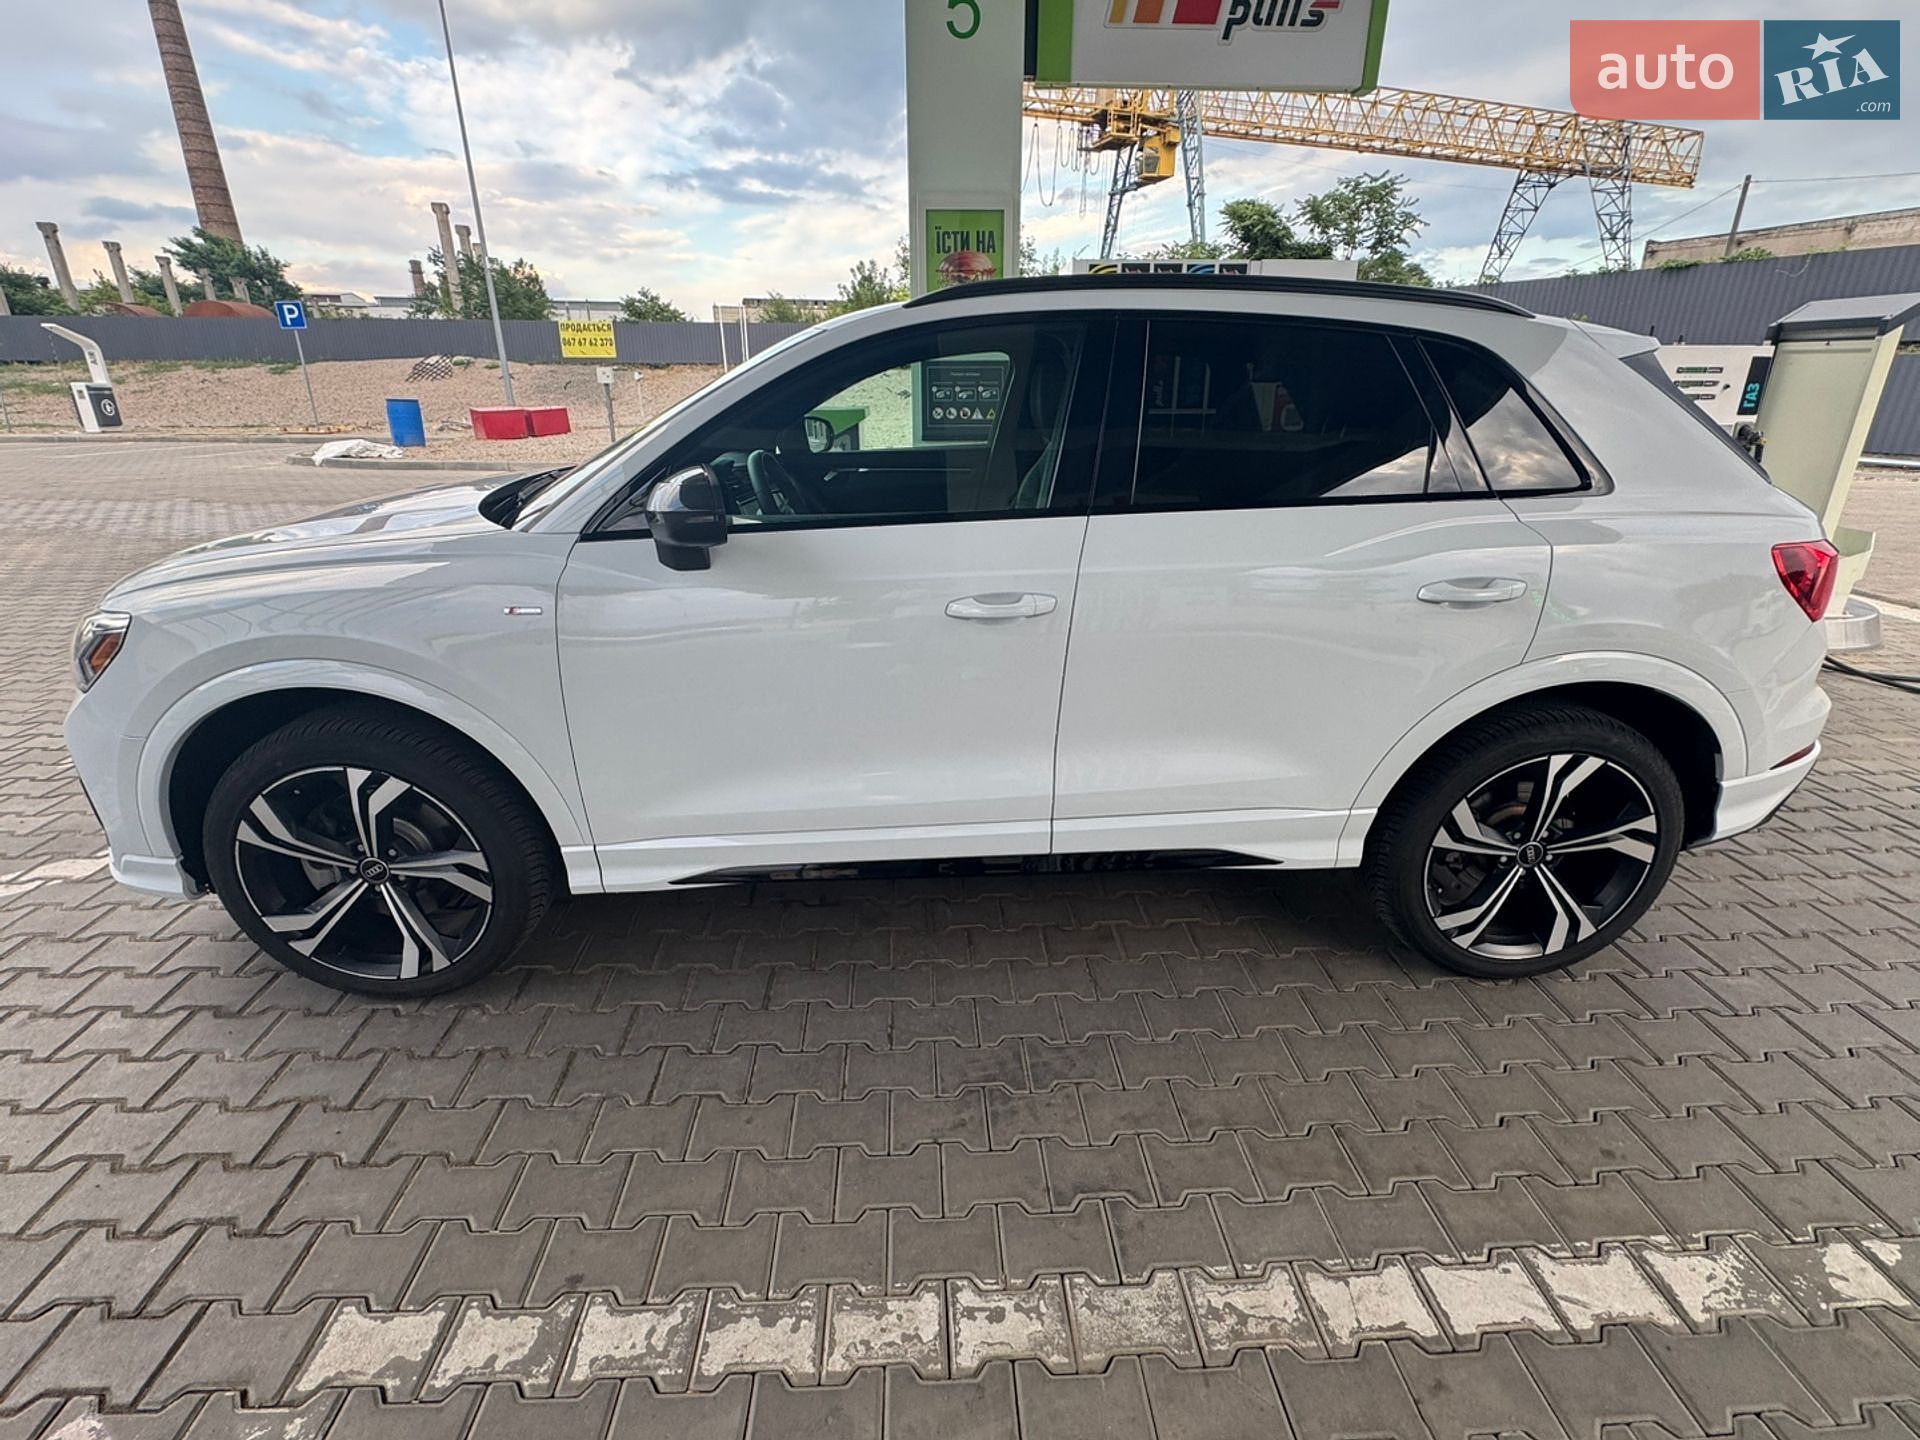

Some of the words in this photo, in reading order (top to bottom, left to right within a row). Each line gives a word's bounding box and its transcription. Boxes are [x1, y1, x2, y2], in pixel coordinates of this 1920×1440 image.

[946, 0, 980, 39] 5
[935, 226, 970, 253] ЇСТИ
[976, 230, 996, 253] НА
[282, 305, 299, 326] P
[1743, 382, 1760, 408] ГАЗ
